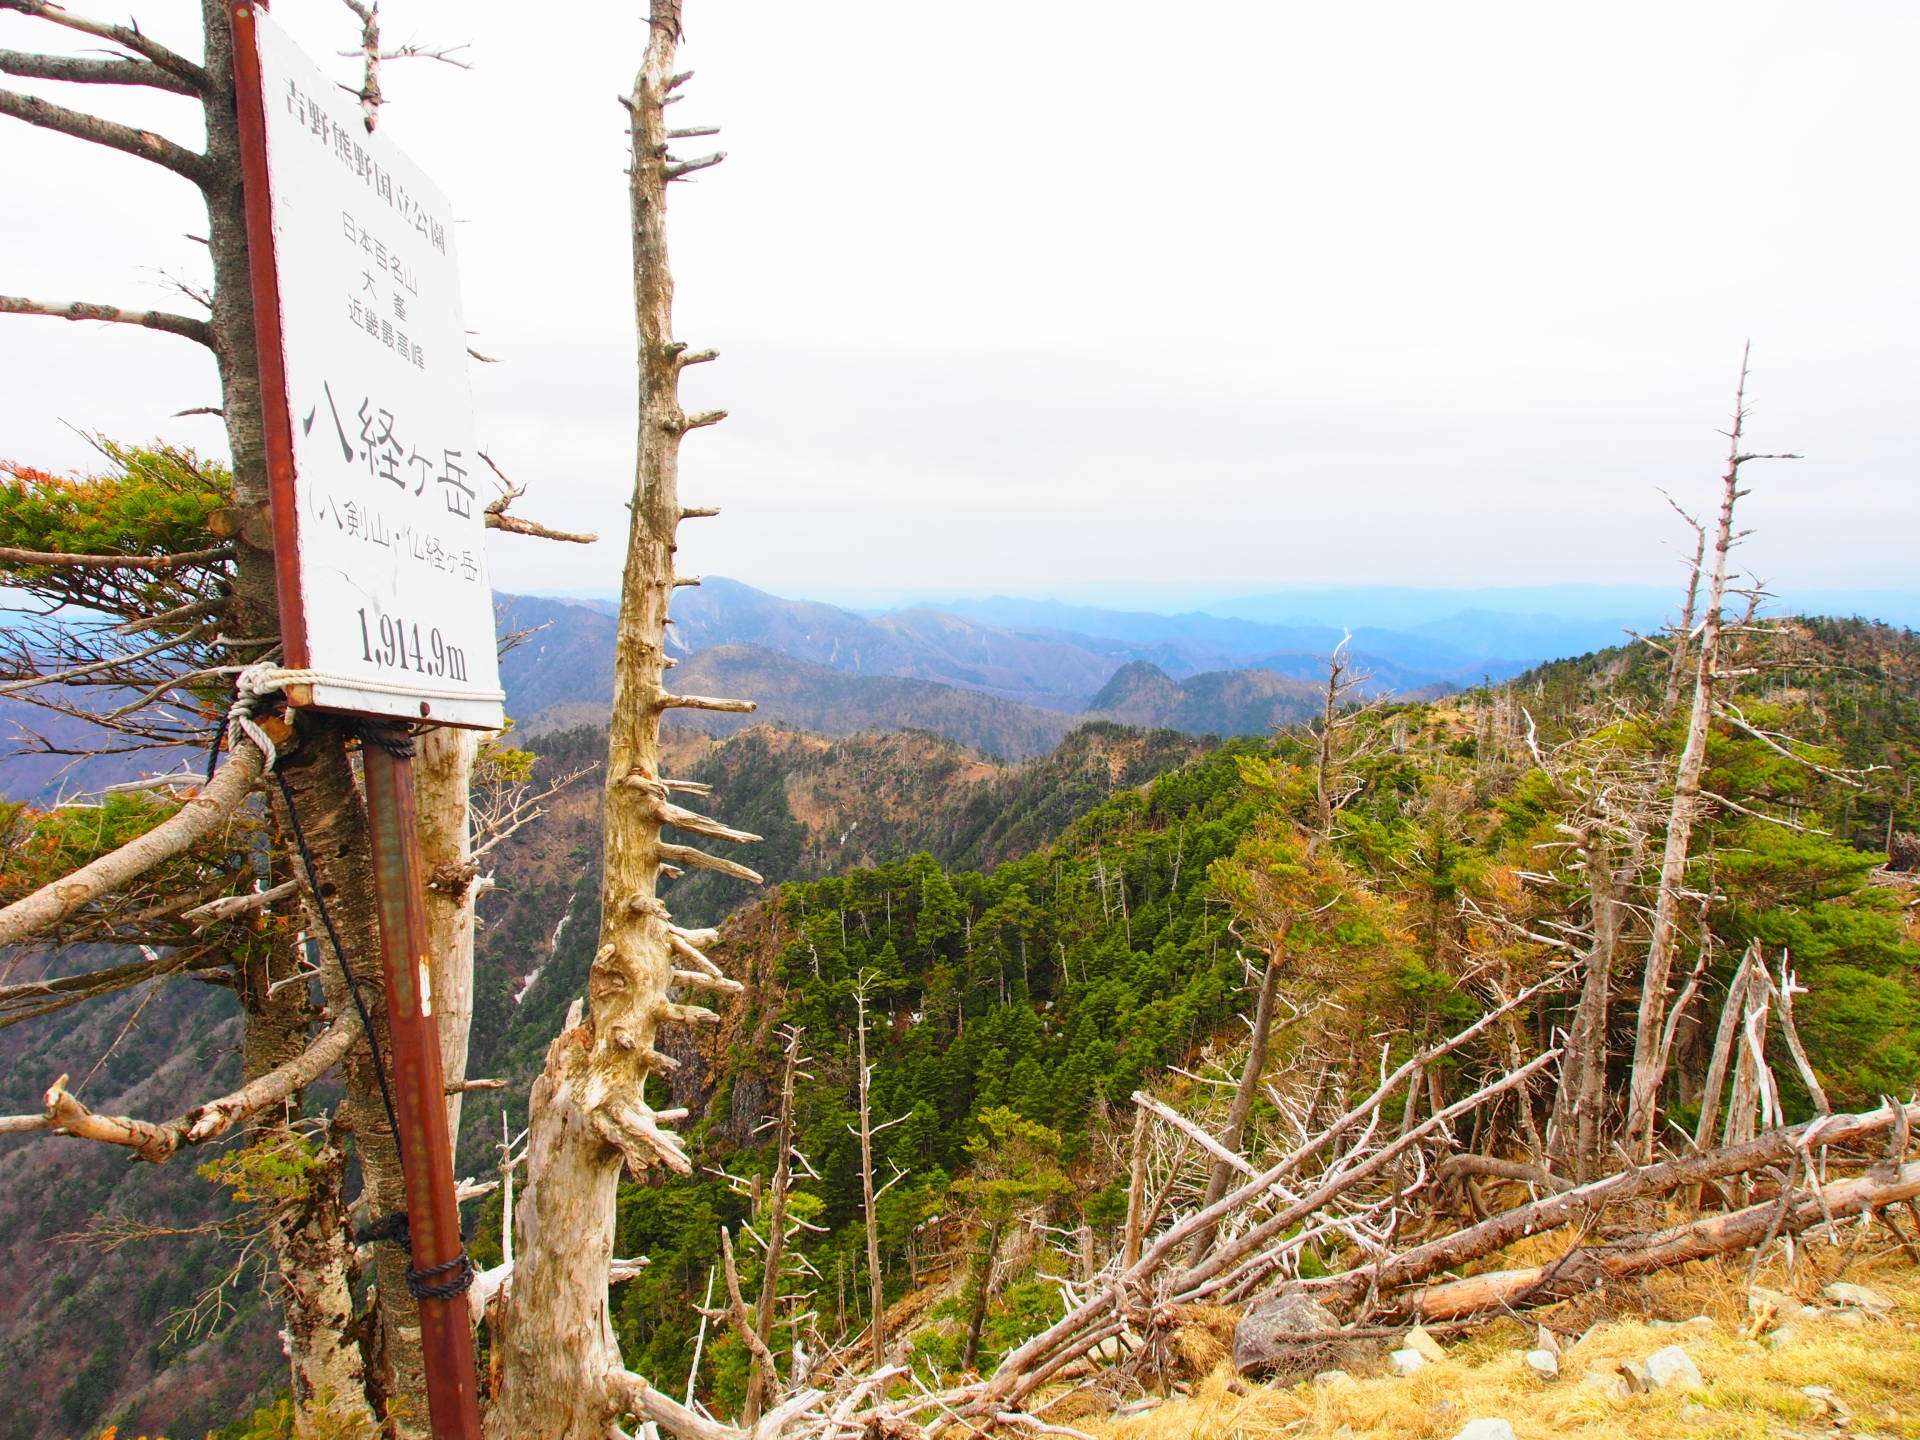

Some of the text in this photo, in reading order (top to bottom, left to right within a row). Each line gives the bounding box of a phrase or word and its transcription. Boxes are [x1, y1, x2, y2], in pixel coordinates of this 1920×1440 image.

[283, 77, 446, 256] 吉野熊野国立公園
[343, 210, 418, 297] 日本百名山
[348, 293, 425, 370] 近畿最高峰
[358, 607, 468, 682] 1,914.9m
